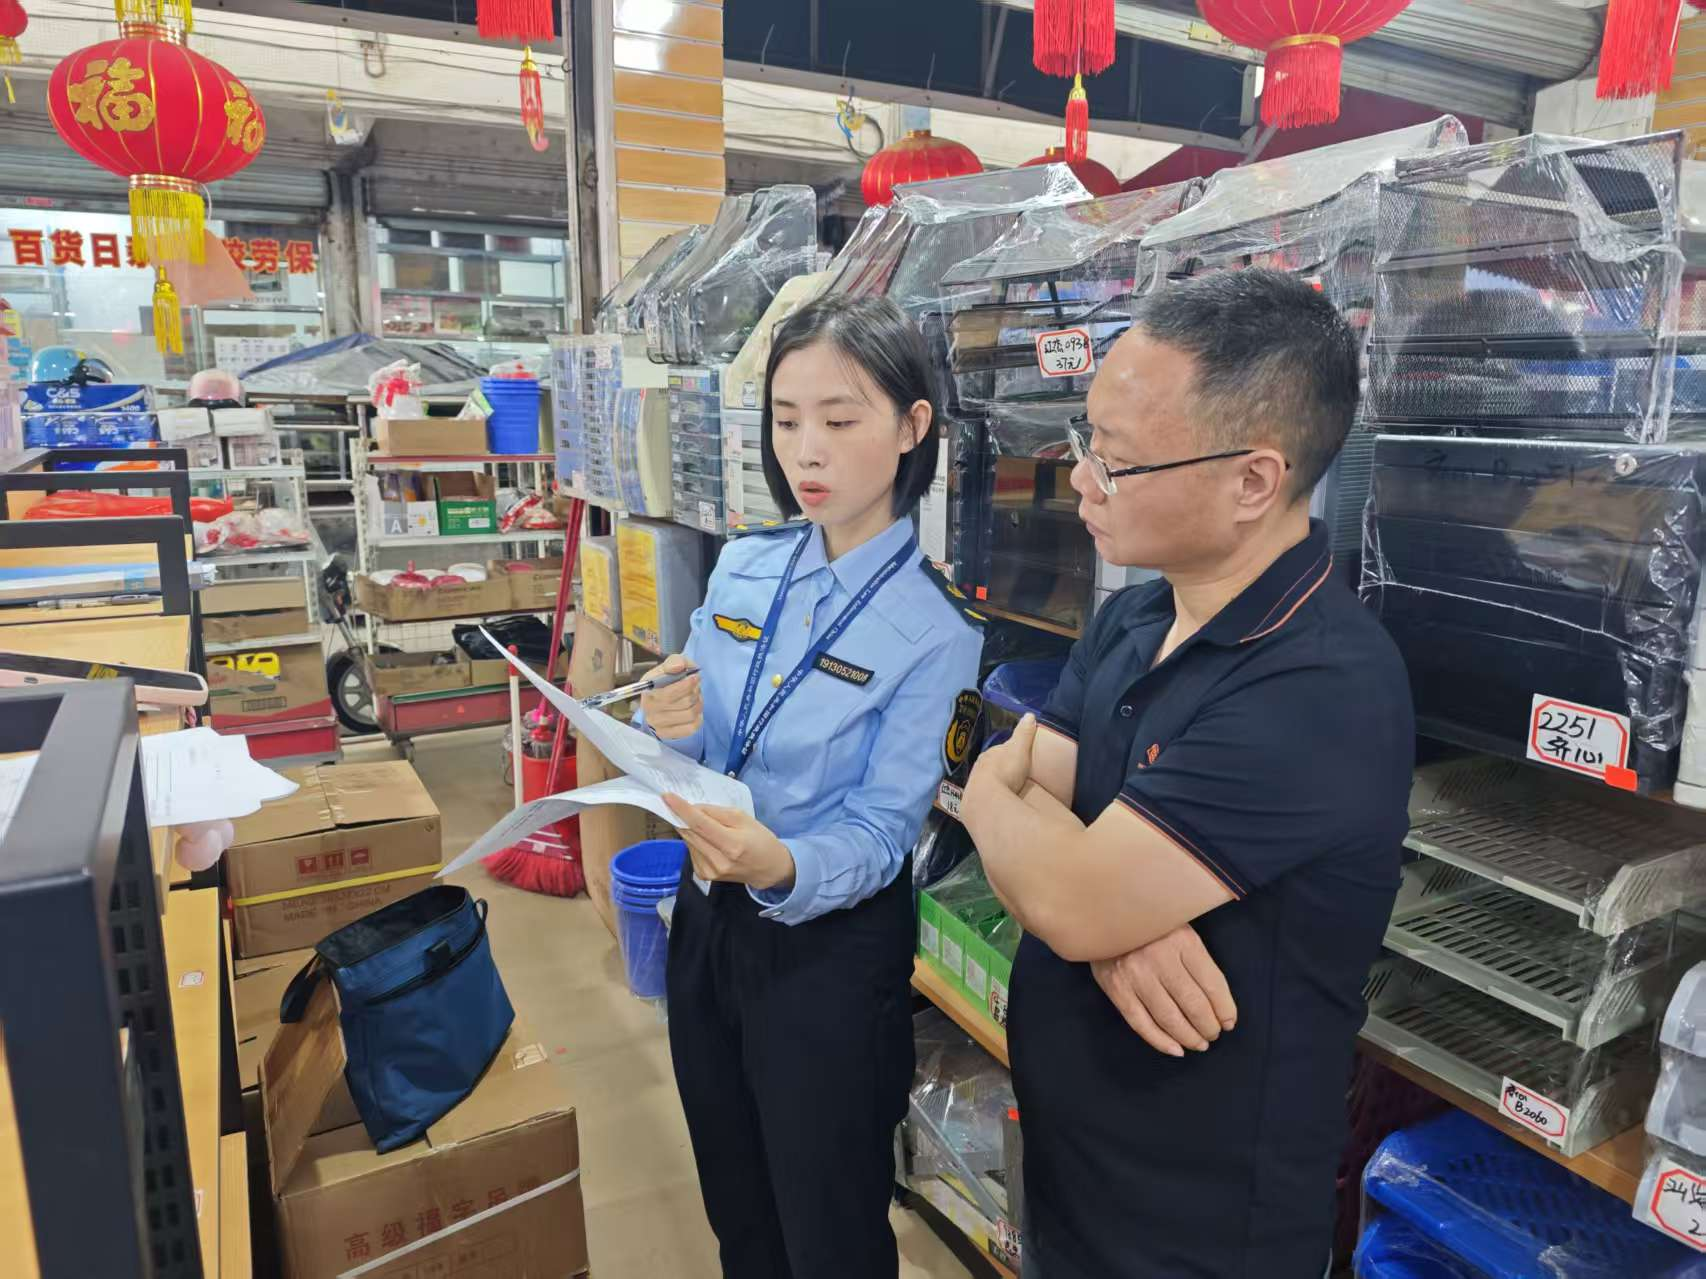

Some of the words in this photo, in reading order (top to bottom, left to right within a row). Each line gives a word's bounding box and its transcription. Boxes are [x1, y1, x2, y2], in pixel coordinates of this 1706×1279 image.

[69, 57, 155, 132] 福
[46, 387, 81, 399] C&S
[391, 519, 402, 533] A
[1538, 711, 1597, 739] 2251
[1515, 1100, 1548, 1126] B2060
